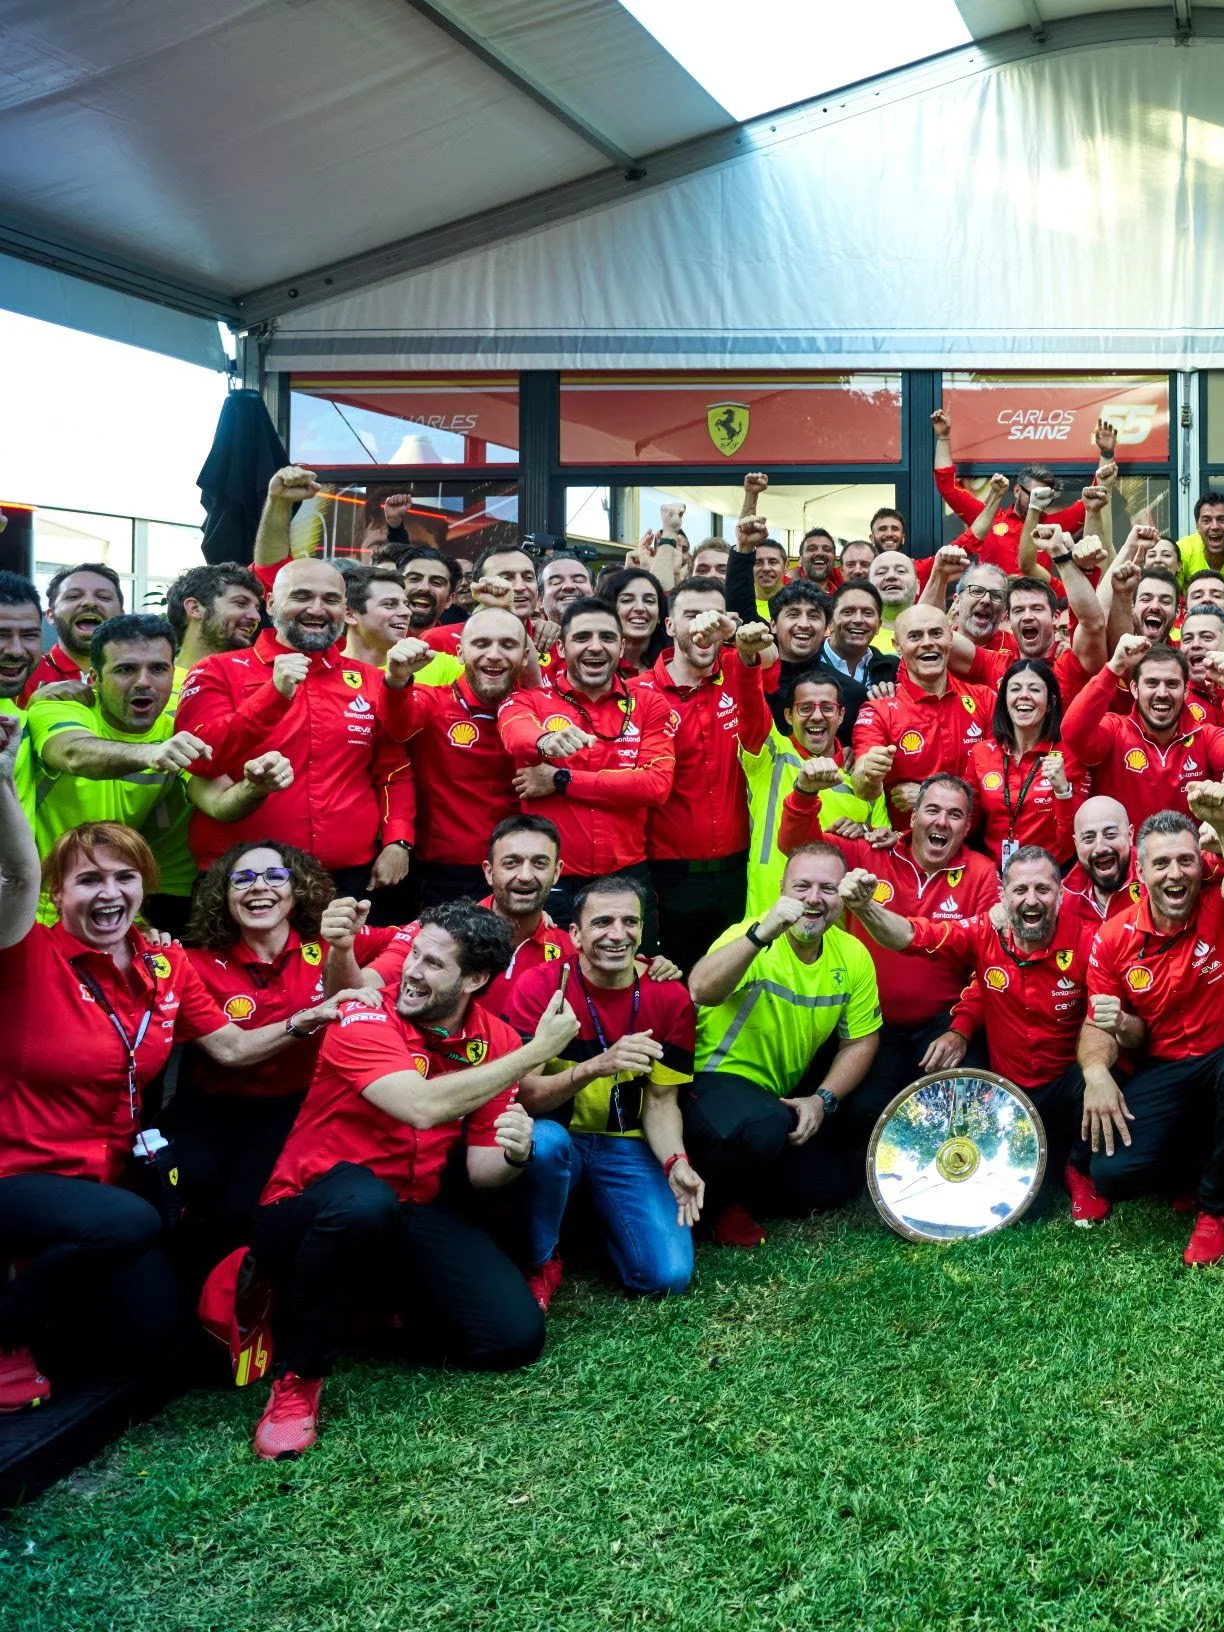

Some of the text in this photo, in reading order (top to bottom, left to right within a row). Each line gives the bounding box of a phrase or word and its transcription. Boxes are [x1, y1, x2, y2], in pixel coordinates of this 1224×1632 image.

[390, 414, 478, 429] ARLES
[997, 409, 1077, 424] CARLOS
[1008, 425, 1072, 440] SAINZ
[344, 710, 375, 719] Santande
[1199, 961, 1222, 976] EVA
